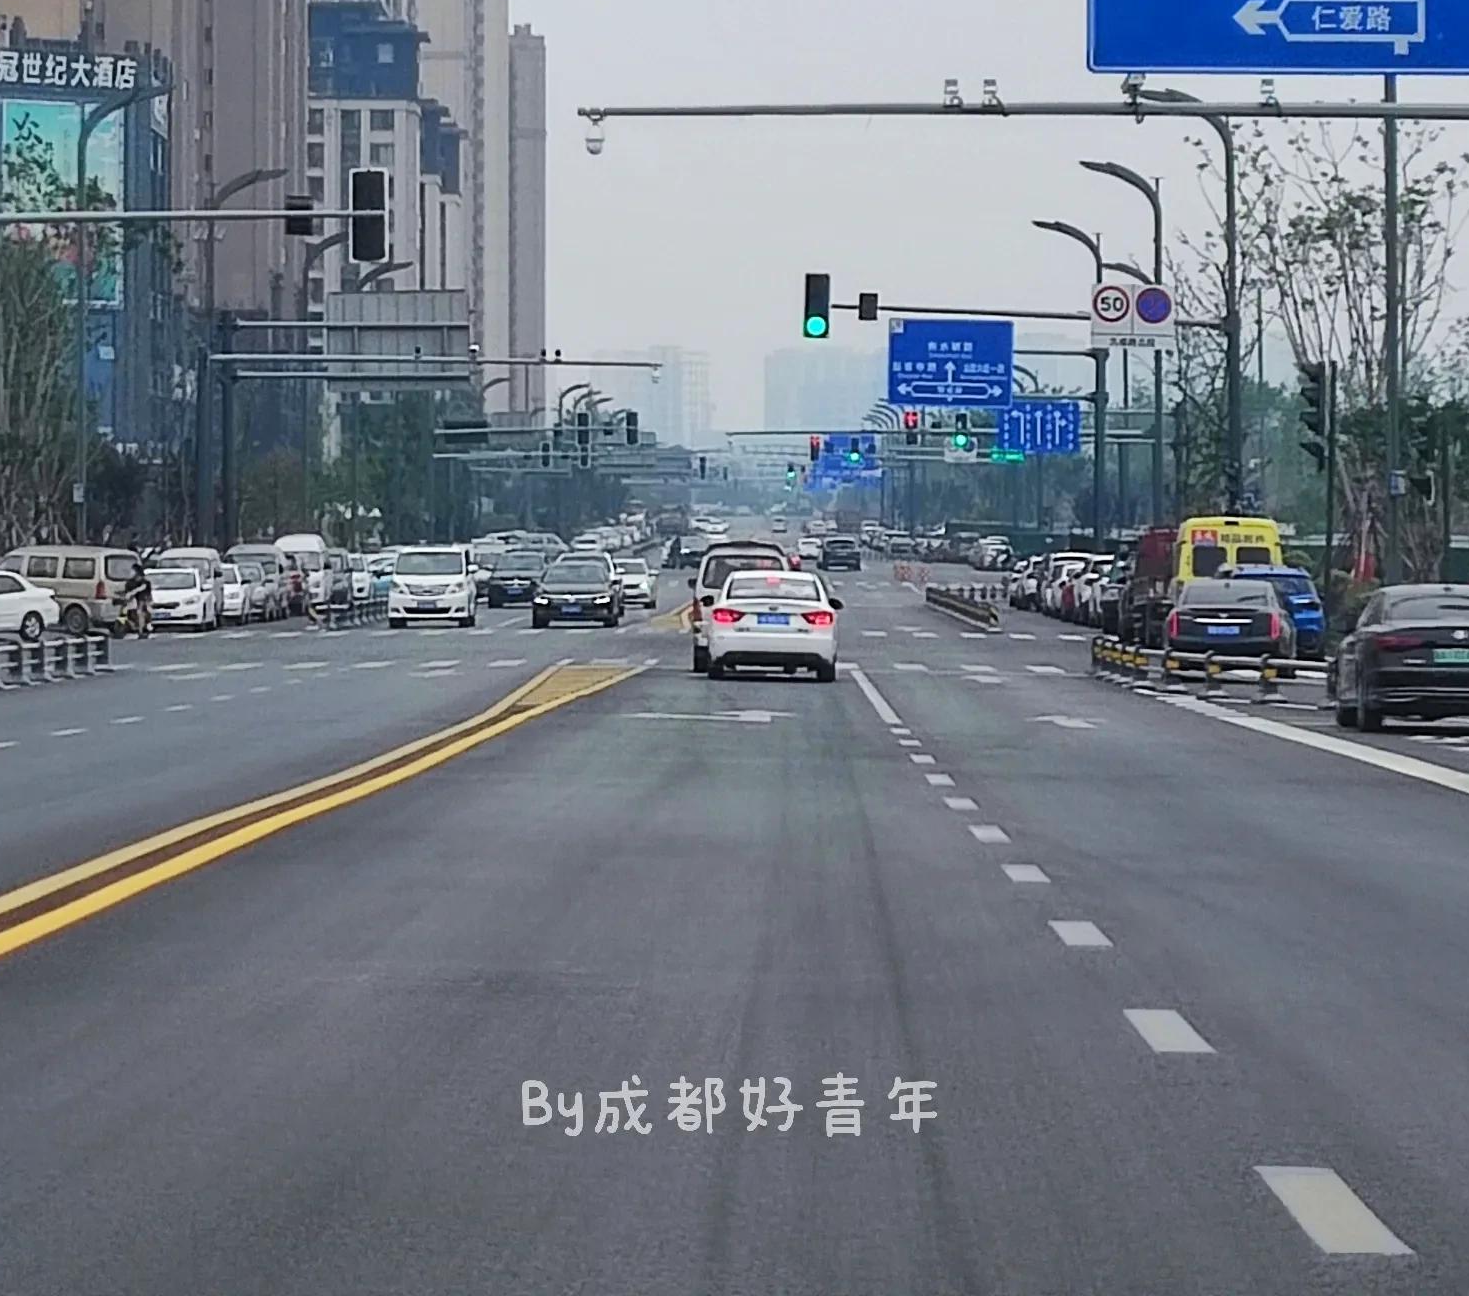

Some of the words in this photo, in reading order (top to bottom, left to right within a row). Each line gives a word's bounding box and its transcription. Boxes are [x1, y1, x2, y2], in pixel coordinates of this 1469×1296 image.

[1311, 5, 1392, 32] 仁爱路
[1100, 296, 1124, 312] 50
